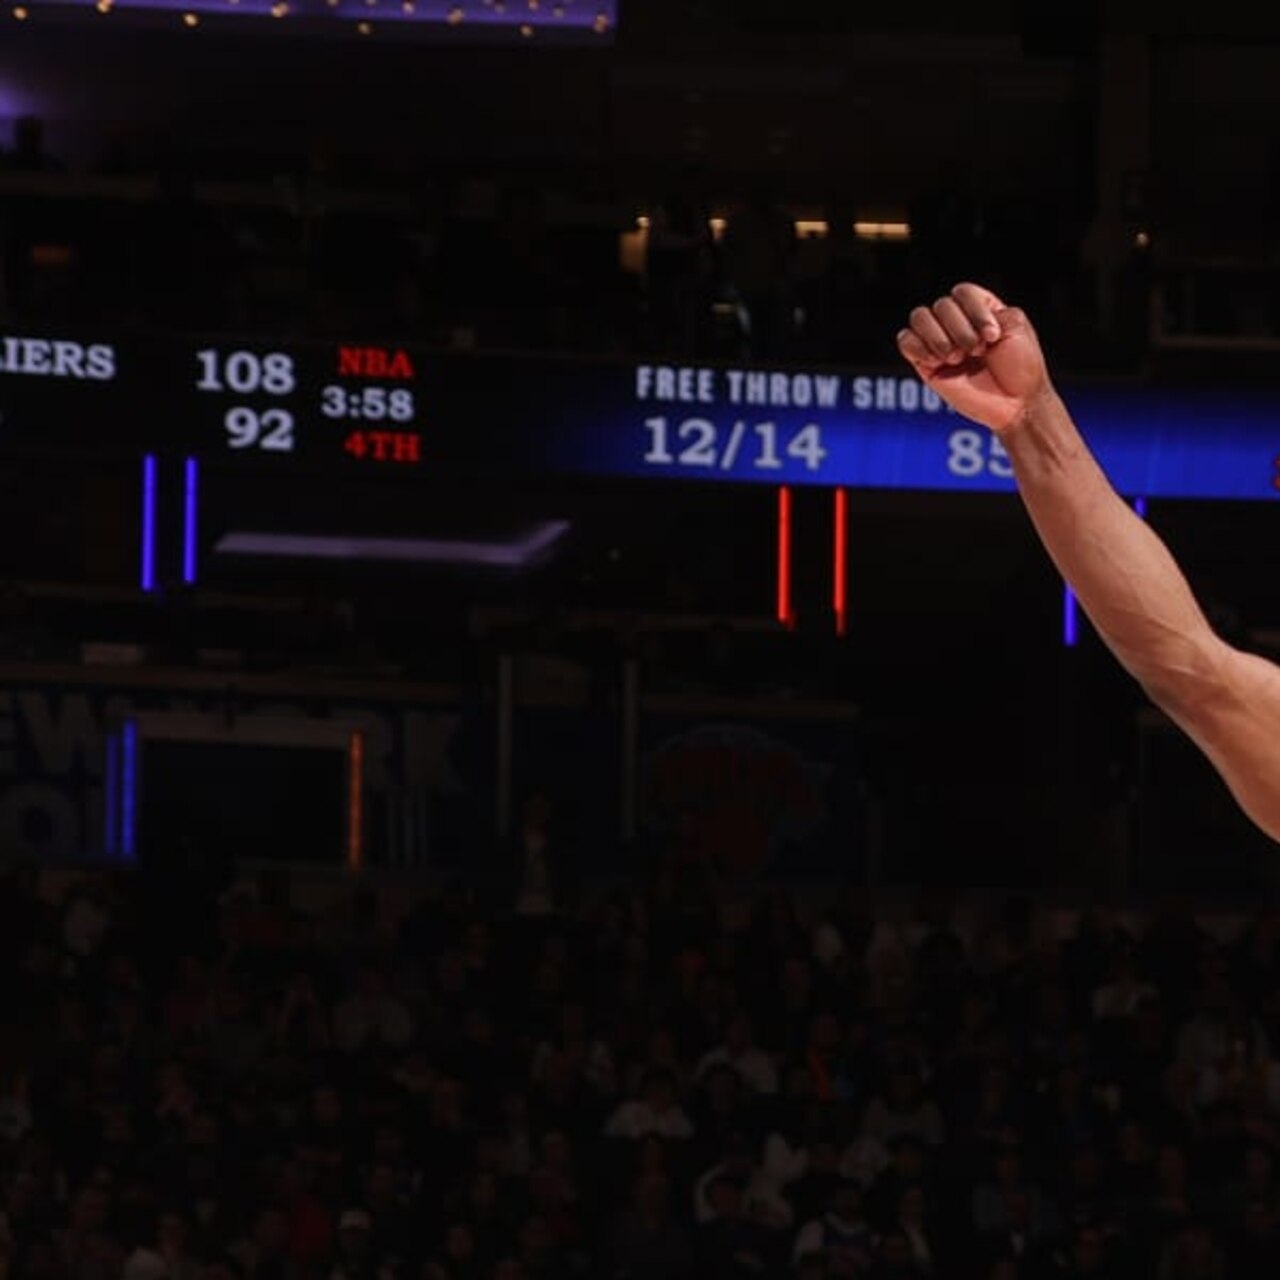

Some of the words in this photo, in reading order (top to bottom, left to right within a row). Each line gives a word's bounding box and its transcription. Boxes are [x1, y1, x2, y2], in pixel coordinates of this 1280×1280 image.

[0, 337, 115, 380] IERS
[197, 350, 295, 394] 108
[339, 347, 414, 378] NBA
[321, 386, 415, 421] 3:58
[636, 366, 714, 402] FREE
[727, 371, 840, 407] THROW
[852, 376, 958, 413] SHOO
[225, 407, 294, 451] 92
[344, 431, 421, 462] 4TH
[644, 417, 827, 470] 12/14
